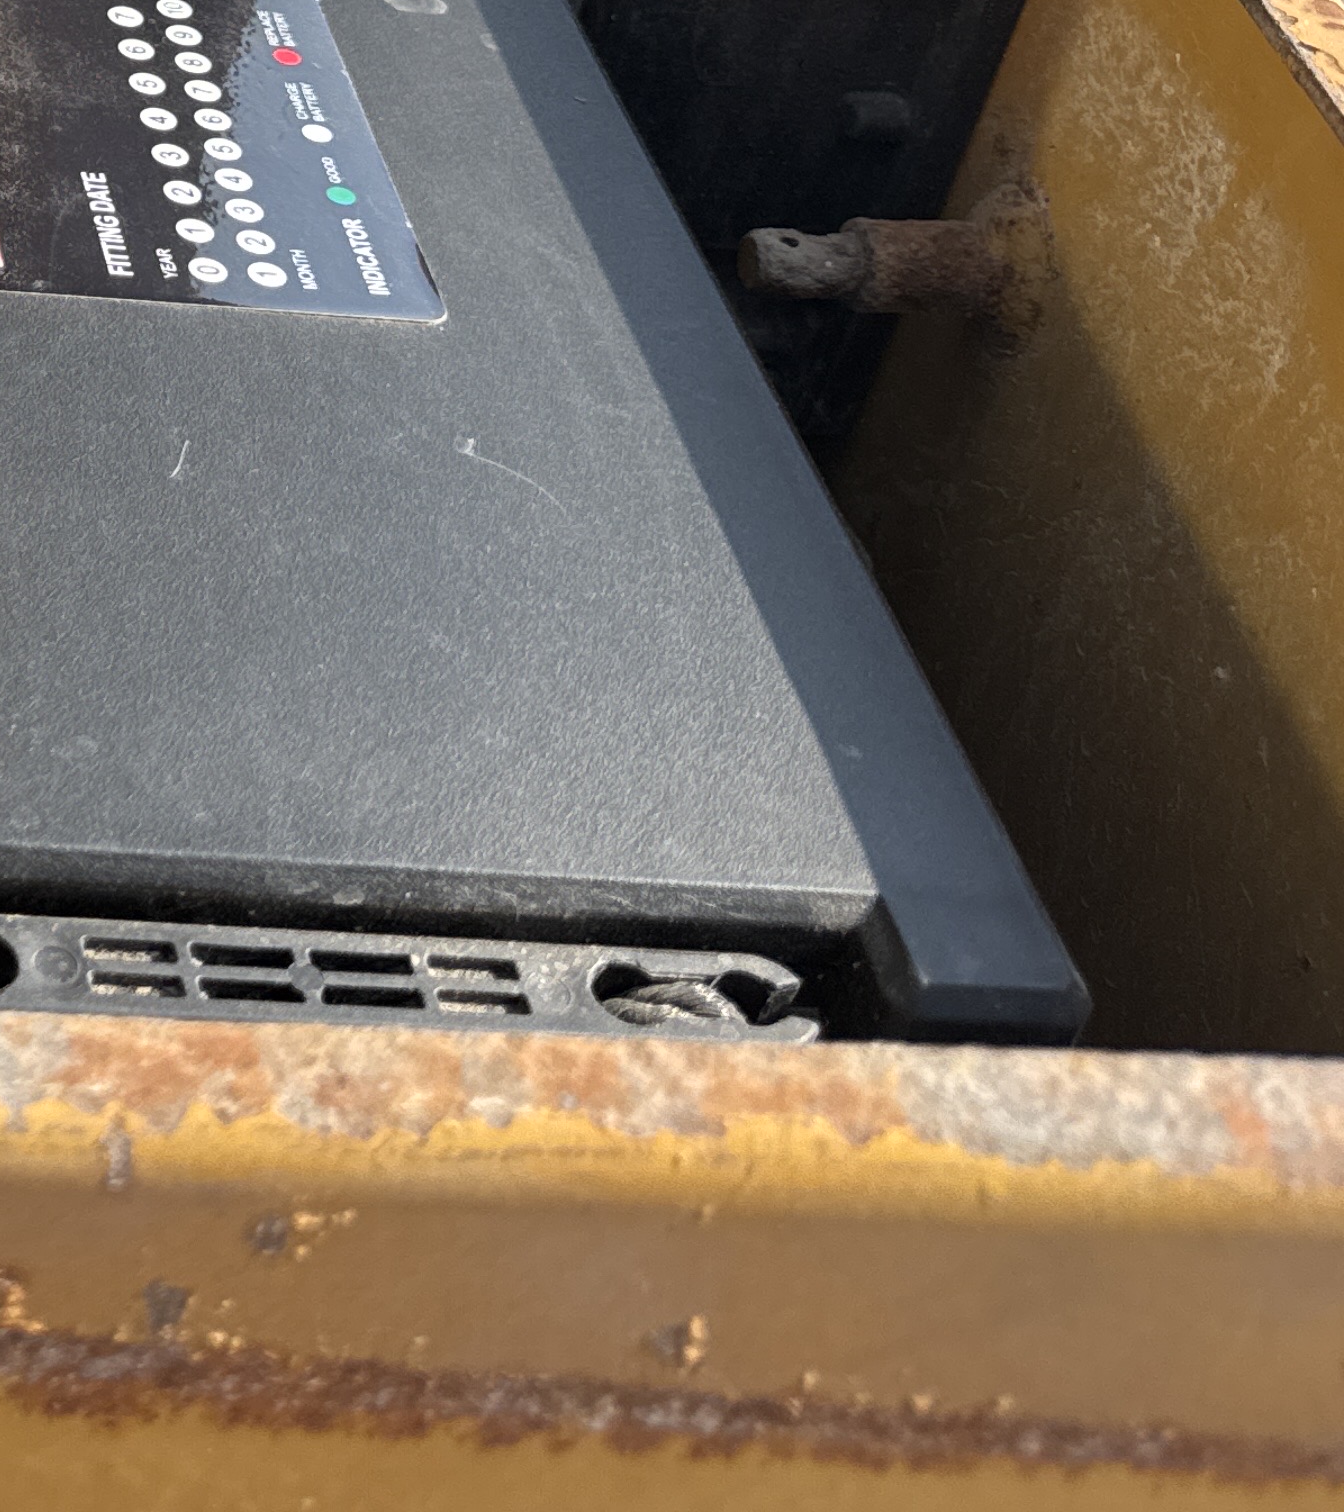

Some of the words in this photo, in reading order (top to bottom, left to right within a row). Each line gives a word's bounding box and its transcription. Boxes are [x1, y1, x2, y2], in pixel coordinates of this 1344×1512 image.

[256, 9, 280, 47] REPLACE
[272, 11, 297, 47] BATTERY
[283, 81, 310, 120] CHARGE
[298, 82, 325, 123] BATTERY
[321, 156, 343, 184] GOOD
[80, 170, 111, 213] DATE
[92, 213, 135, 278] FITTING
[154, 247, 180, 279] YEAR
[341, 217, 392, 296] INDICATOR
[288, 249, 319, 291] MONTH
